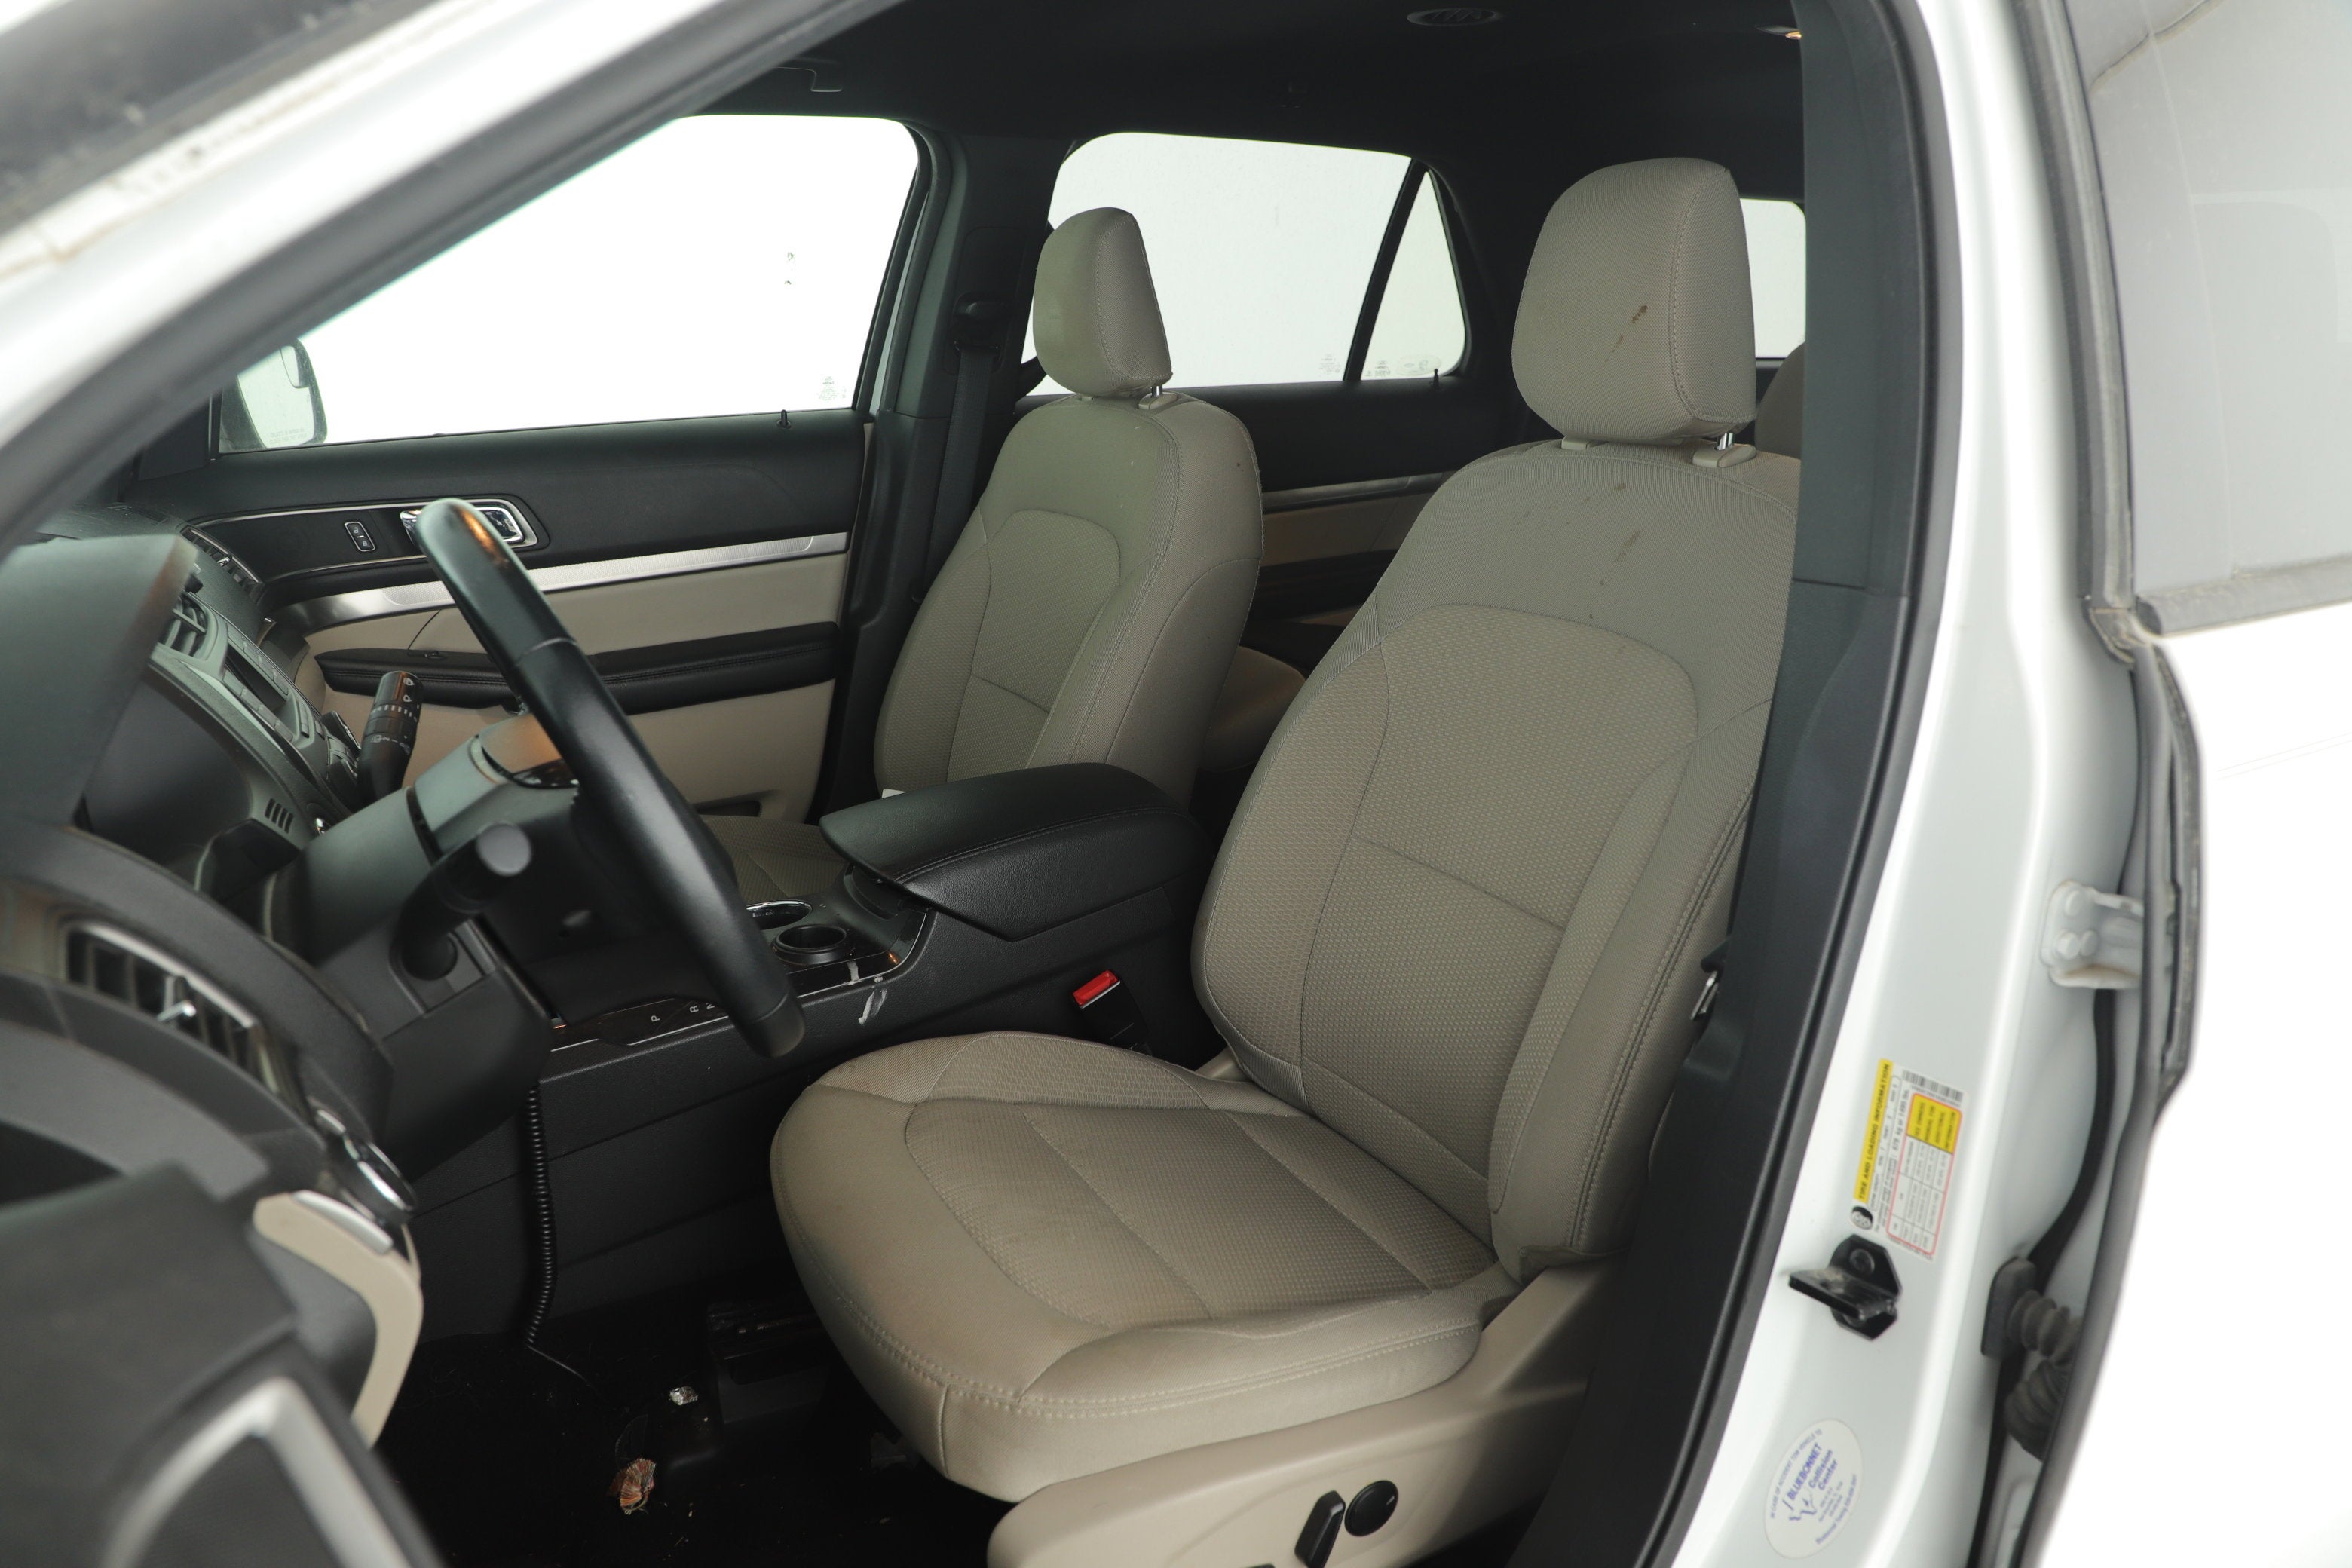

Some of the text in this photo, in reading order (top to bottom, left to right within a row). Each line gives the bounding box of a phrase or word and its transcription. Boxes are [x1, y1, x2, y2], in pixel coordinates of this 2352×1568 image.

[689, 1005, 700, 1013] R
[1873, 1062, 1890, 1121] INFORMATION
[1866, 1122, 1877, 1159] LOADING
[1862, 1161, 1870, 1178] AND
[1858, 1181, 1867, 1199] TIRE
[1786, 1442, 1823, 1501] BLUEBONNET
[1808, 1448, 1833, 1489] Collision
[1817, 1458, 1839, 1490] Center
